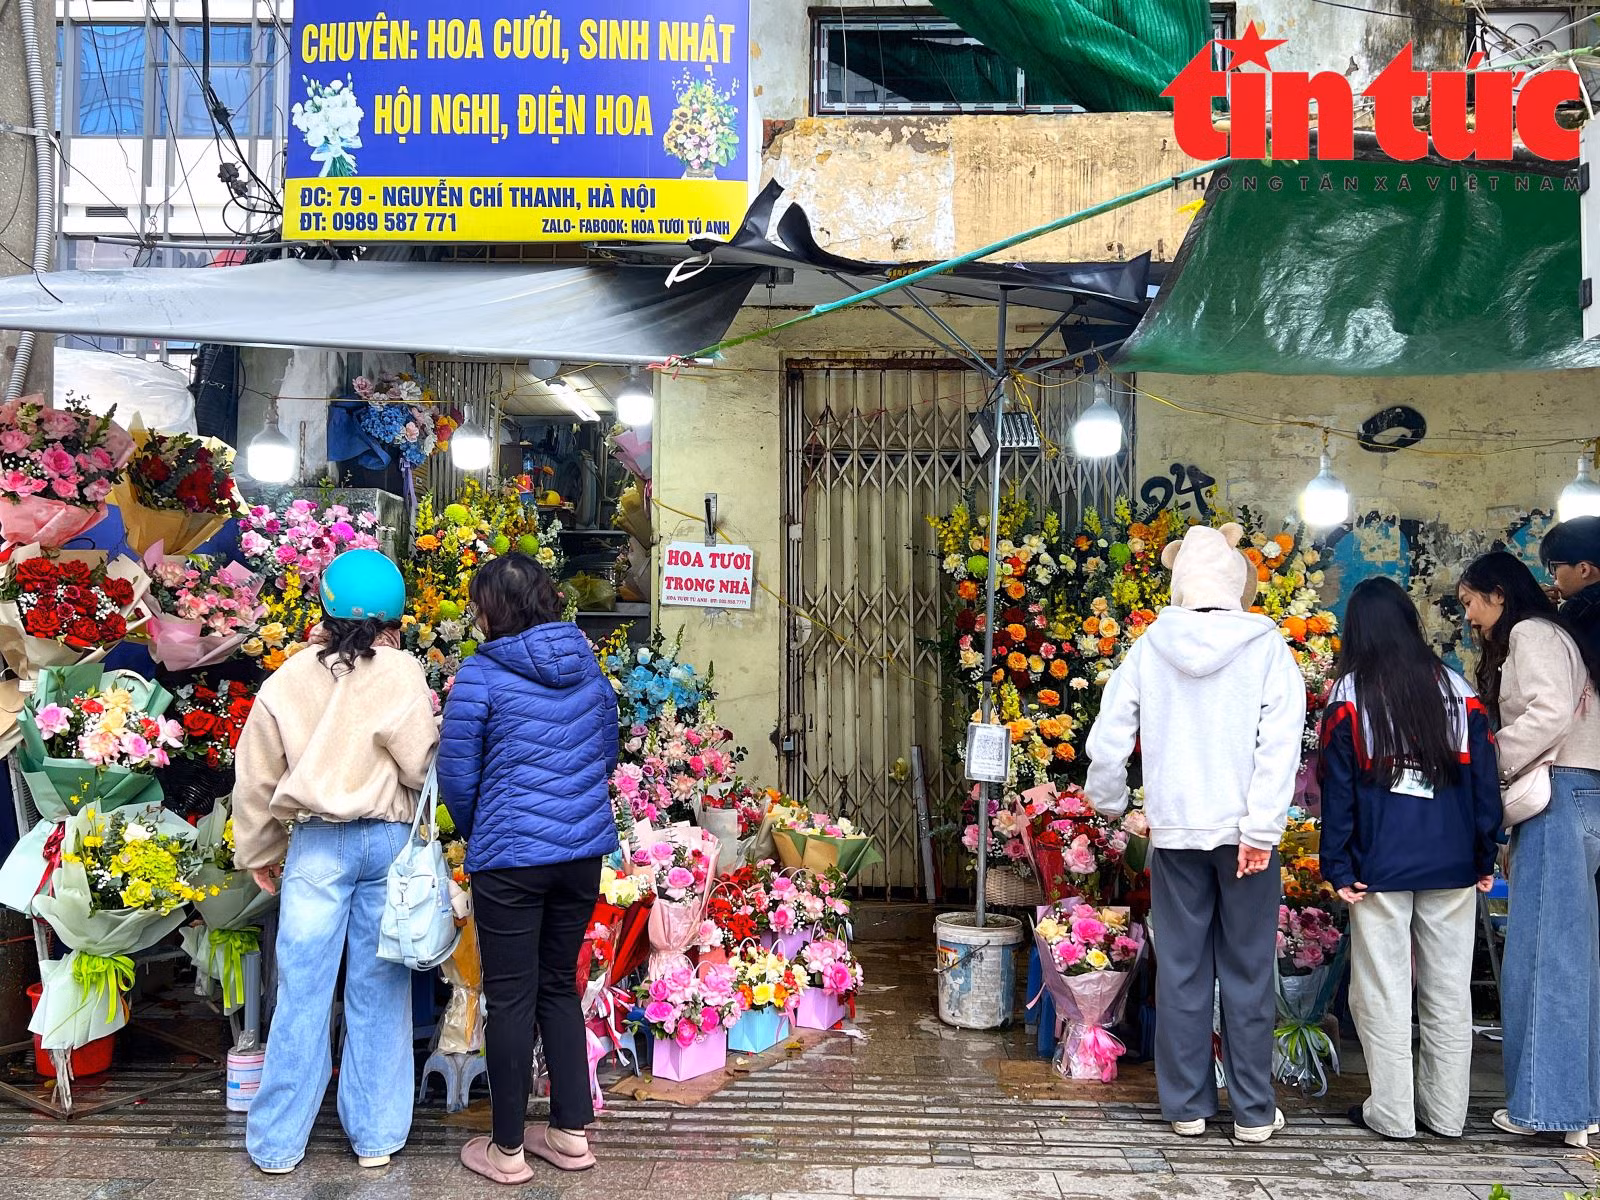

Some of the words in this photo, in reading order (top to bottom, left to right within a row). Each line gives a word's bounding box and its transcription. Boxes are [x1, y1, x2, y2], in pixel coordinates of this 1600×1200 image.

[302, 12, 418, 63] CHUYÊN:
[427, 19, 484, 59] HOA
[493, 10, 569, 64] CƯỚI,
[579, 19, 649, 60] SINH
[658, 14, 735, 72] NHẬT
[374, 86, 421, 144] HỘI
[431, 93, 508, 144] NGHỊ,
[517, 85, 585, 144] ĐIỆN
[595, 94, 653, 136] HOA
[300, 186, 332, 207] ĐC:
[338, 186, 362, 207] 79
[382, 179, 463, 207] NGUYỄN
[469, 182, 503, 207] CHÍ
[509, 187, 581, 210] THANH,
[588, 183, 615, 208] HÀ
[621, 183, 656, 213] NỘI
[300, 212, 326, 231] ĐT:
[332, 212, 378, 231] 0989
[384, 212, 418, 231] 587
[424, 212, 457, 232] 771
[579, 219, 628, 234] FABOOK:
[632, 219, 655, 234] HOA
[658, 217, 684, 234] TƯƠI
[687, 217, 701, 234] TÚ
[706, 220, 730, 235] ANH
[667, 550, 704, 567] HOA
[709, 552, 751, 569] TƯƠI
[665, 576, 715, 593] TRONG
[719, 577, 750, 595] NHÀ
